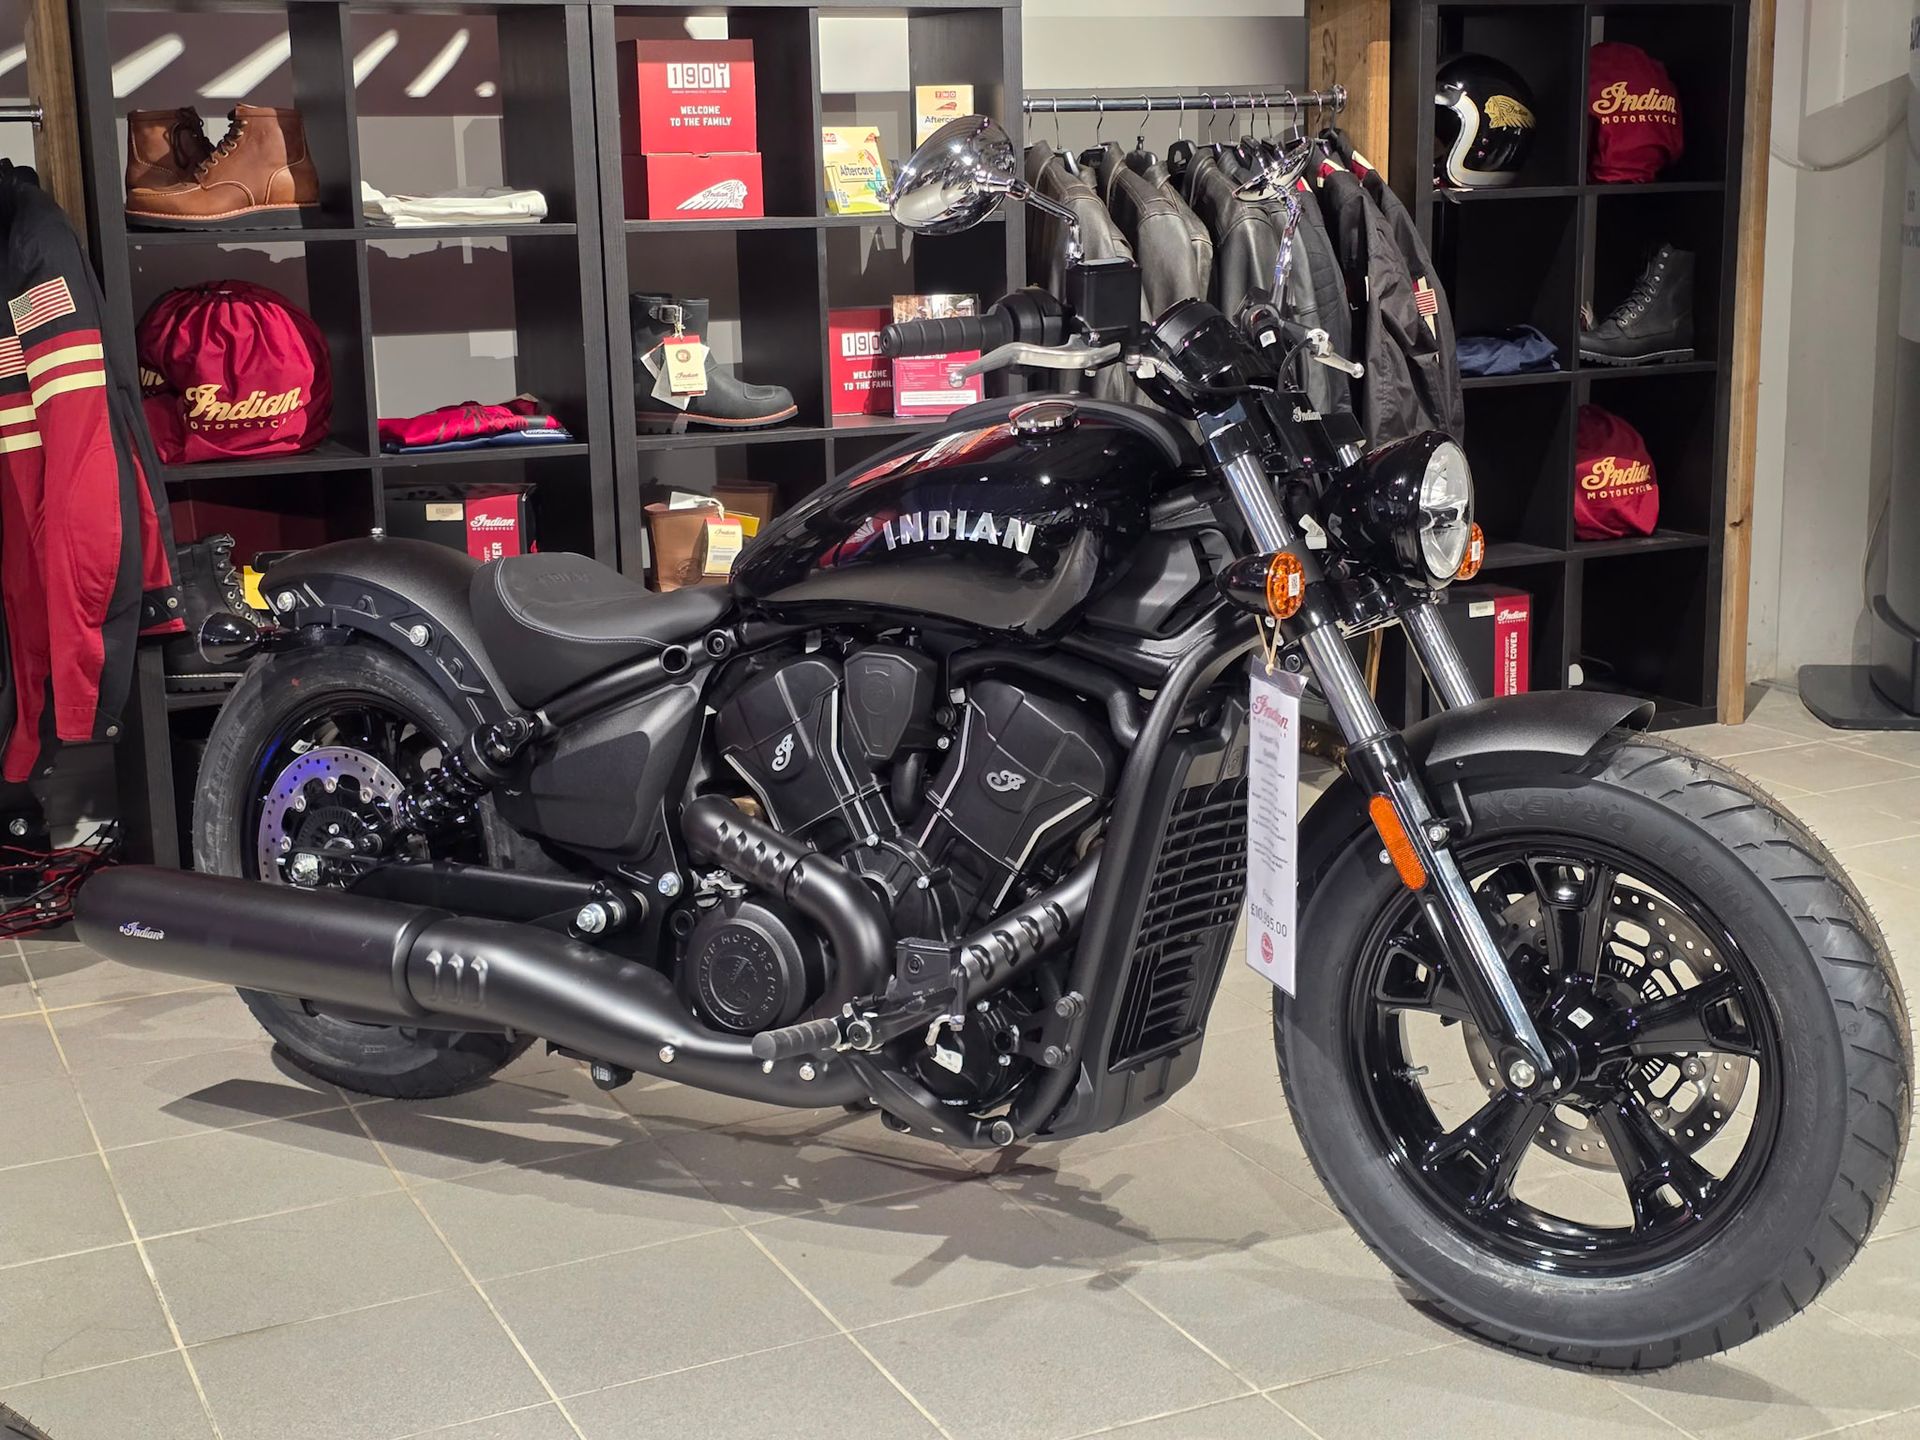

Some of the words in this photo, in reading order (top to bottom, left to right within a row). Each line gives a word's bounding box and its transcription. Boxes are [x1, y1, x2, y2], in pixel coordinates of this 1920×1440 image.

[669, 63, 729, 88] 1901
[1593, 81, 1677, 114] Indian
[680, 105, 721, 115] WELCOME
[670, 117, 681, 127] TO
[684, 117, 700, 127] THE
[703, 117, 732, 127] FAMILY
[840, 165, 874, 176] Aftercare
[843, 332, 881, 355] 190
[853, 370, 887, 379] WELCOME
[844, 382, 853, 390] TO
[856, 382, 870, 390] THE
[872, 381, 892, 389] FAMIL
[185, 383, 303, 421] Indian
[1292, 402, 1322, 423] Indian
[470, 514, 515, 527] Indian
[882, 508, 1037, 555] INDIAN
[1497, 609, 1527, 621] Indian
[1510, 631, 1518, 660] COVER
[120, 921, 165, 940] Indian
